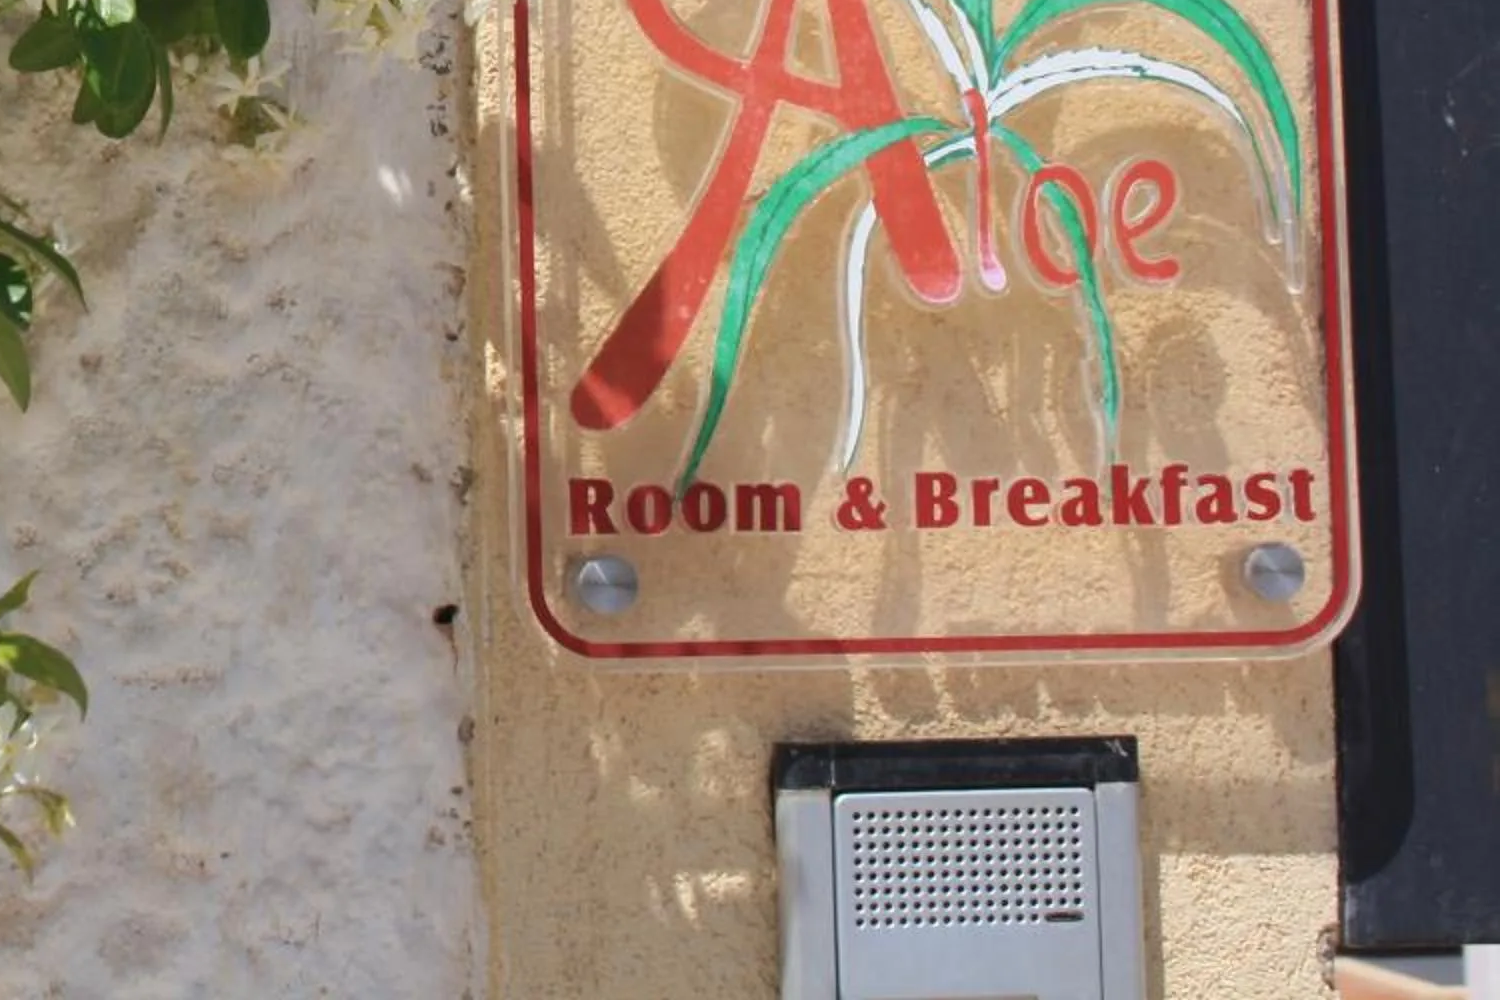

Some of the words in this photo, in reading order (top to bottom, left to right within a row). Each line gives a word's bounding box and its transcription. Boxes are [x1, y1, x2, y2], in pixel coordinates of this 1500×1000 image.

[570, 477, 801, 535] Room
[838, 477, 887, 531] &
[914, 464, 1317, 529] Breakfast
